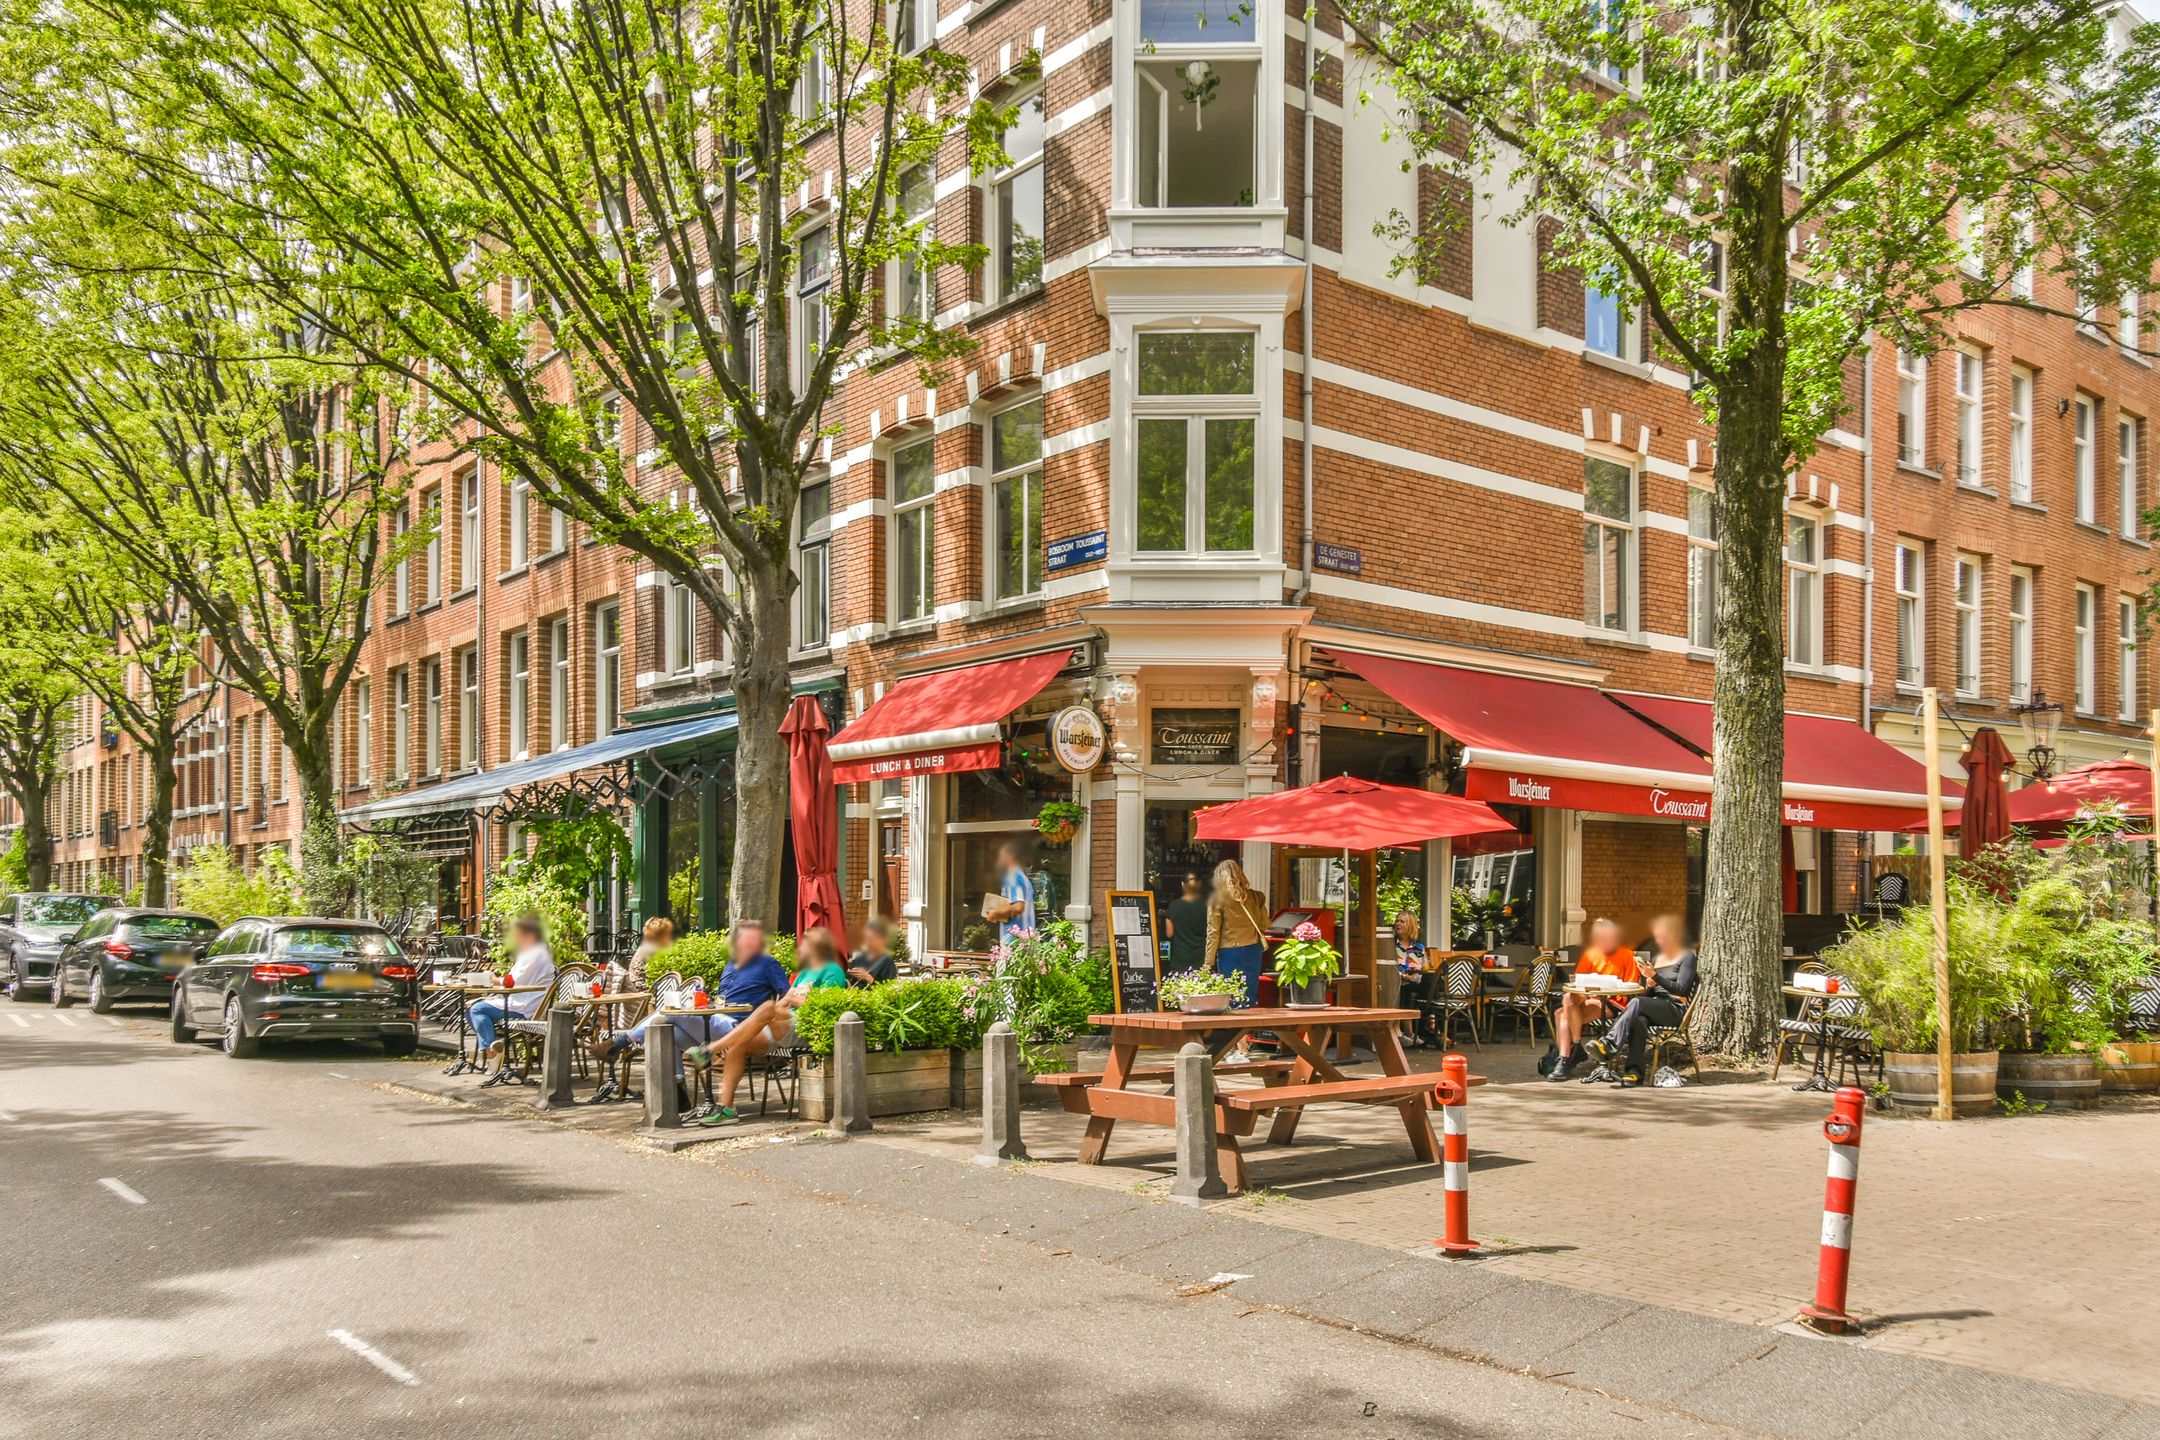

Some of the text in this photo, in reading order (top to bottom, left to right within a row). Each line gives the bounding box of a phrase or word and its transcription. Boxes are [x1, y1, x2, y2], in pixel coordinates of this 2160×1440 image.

[1048, 533, 1105, 557] BOSBOOM TOUSSAINT
[1320, 545, 1357, 561] DE GENESTET
[1048, 554, 1067, 567] STRAAT
[1318, 556, 1338, 567] STRAAT
[1059, 728, 1101, 748] Warsteiner
[1158, 727, 1232, 744] Toussaint
[870, 755, 945, 774] LUNCH & DINER
[1508, 777, 1551, 801] Warsteiner
[1650, 789, 1708, 818] Toussaint
[1784, 803, 1814, 823] Warsteiner
